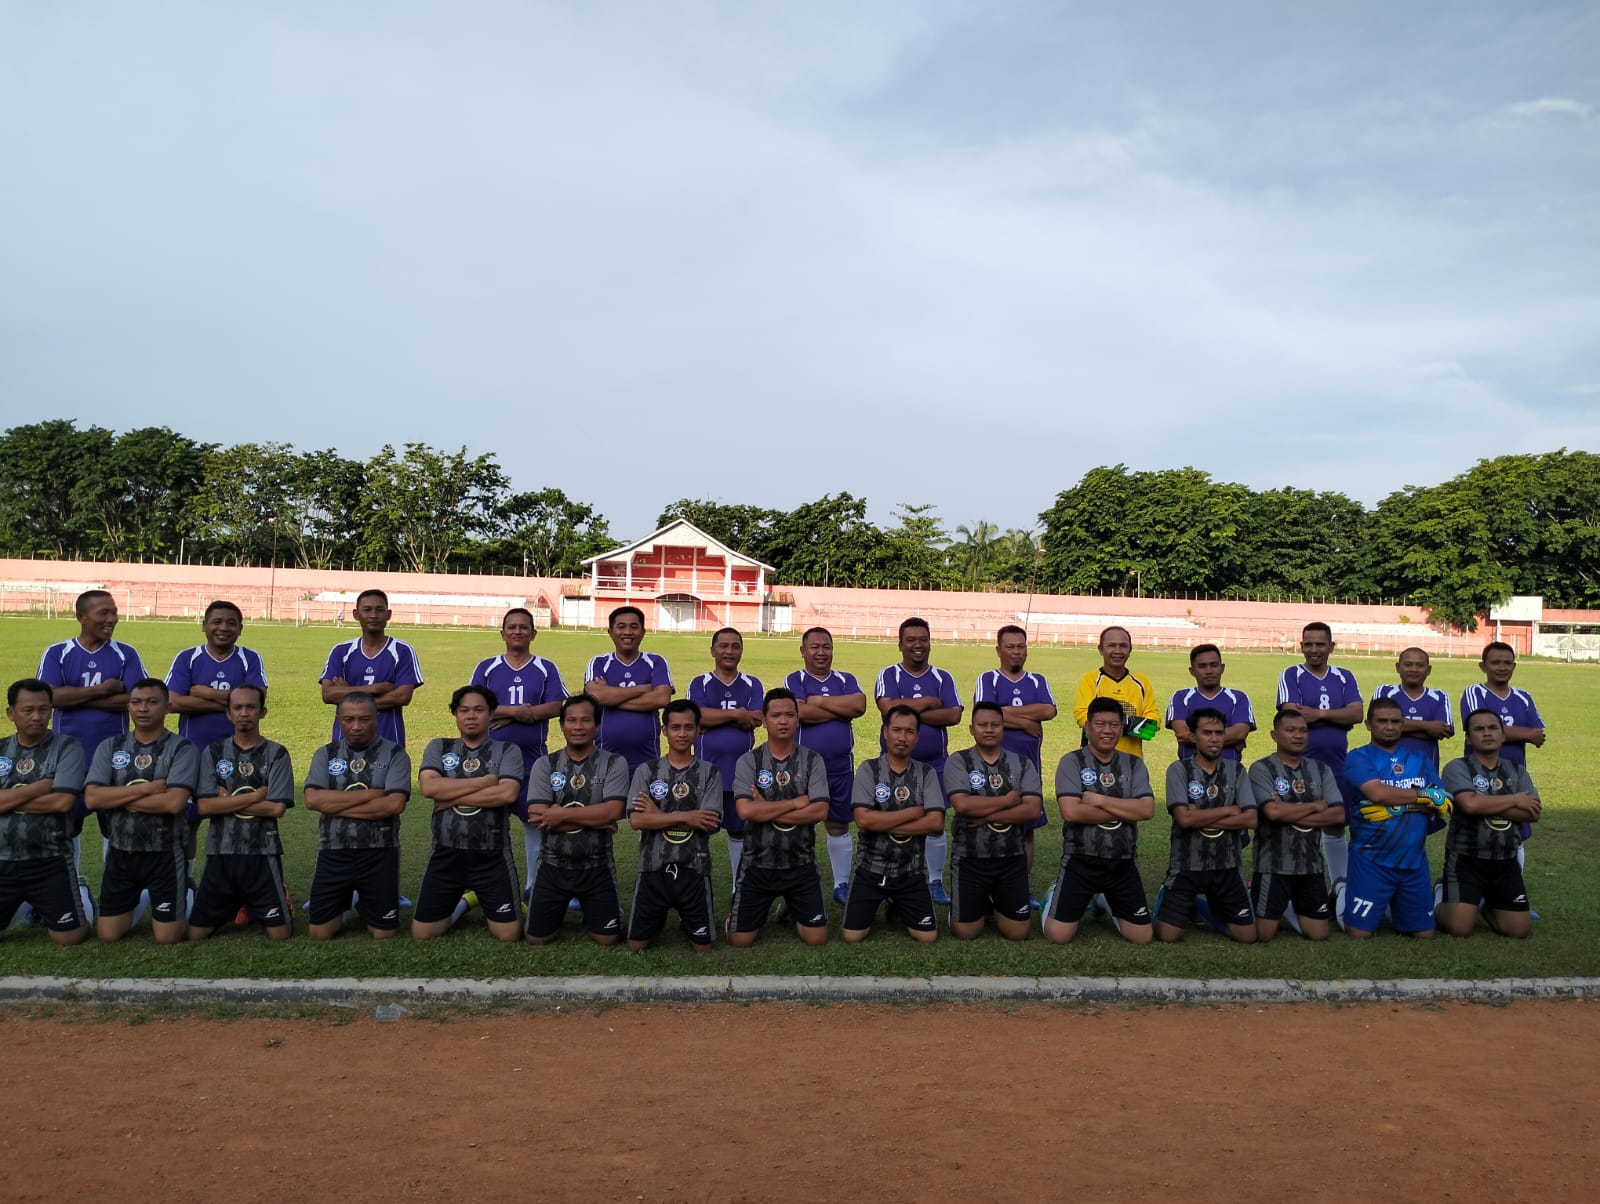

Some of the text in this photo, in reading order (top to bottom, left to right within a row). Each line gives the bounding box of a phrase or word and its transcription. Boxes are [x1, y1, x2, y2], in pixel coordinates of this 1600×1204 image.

[82, 672, 102, 688] 14
[508, 685, 524, 705] 11
[1319, 694, 1330, 710] 8
[1352, 897, 1374, 917] 77
